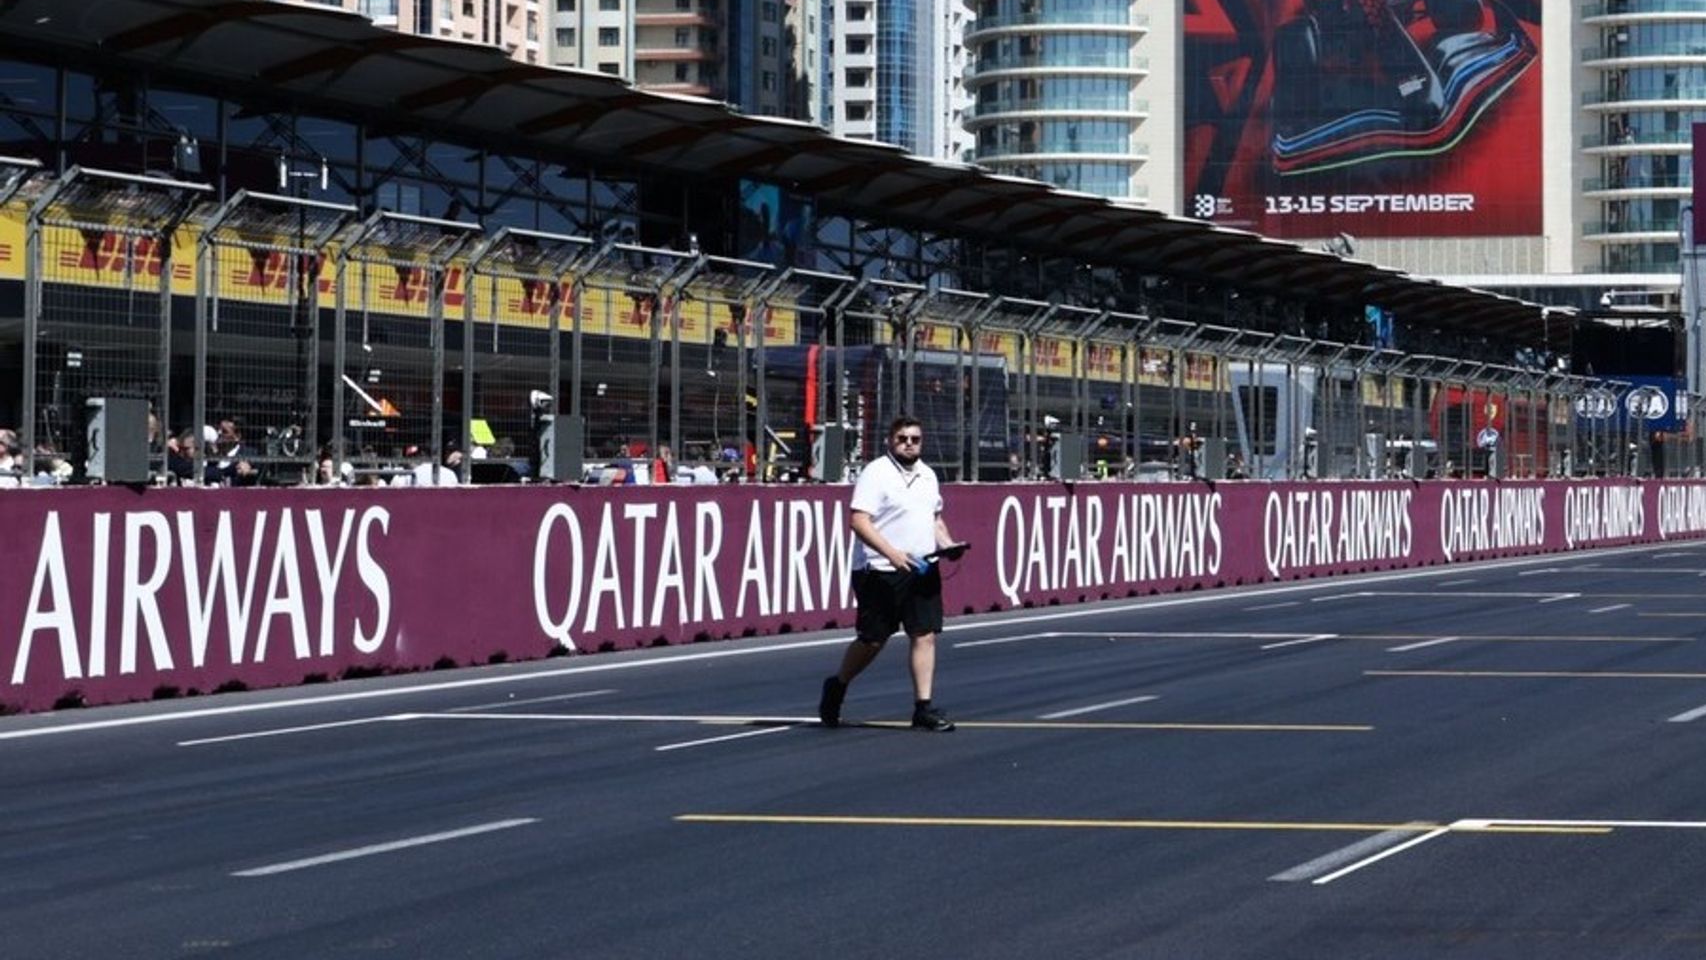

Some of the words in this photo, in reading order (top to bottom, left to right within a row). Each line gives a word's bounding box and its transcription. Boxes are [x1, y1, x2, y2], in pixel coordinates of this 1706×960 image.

[1330, 193, 1475, 214] SEPTEMBER
[996, 495, 1104, 606] QATAR
[1110, 492, 1222, 584] AIRWAYS
[1264, 490, 1334, 577] QATAR
[1336, 489, 1412, 563] AIRWAYS
[1441, 488, 1489, 561] QATAR
[1491, 487, 1545, 549] AIRWAYS
[10, 504, 391, 685] AIRWAYS
[533, 502, 724, 652] QATAR
[736, 499, 857, 618] AIRW
